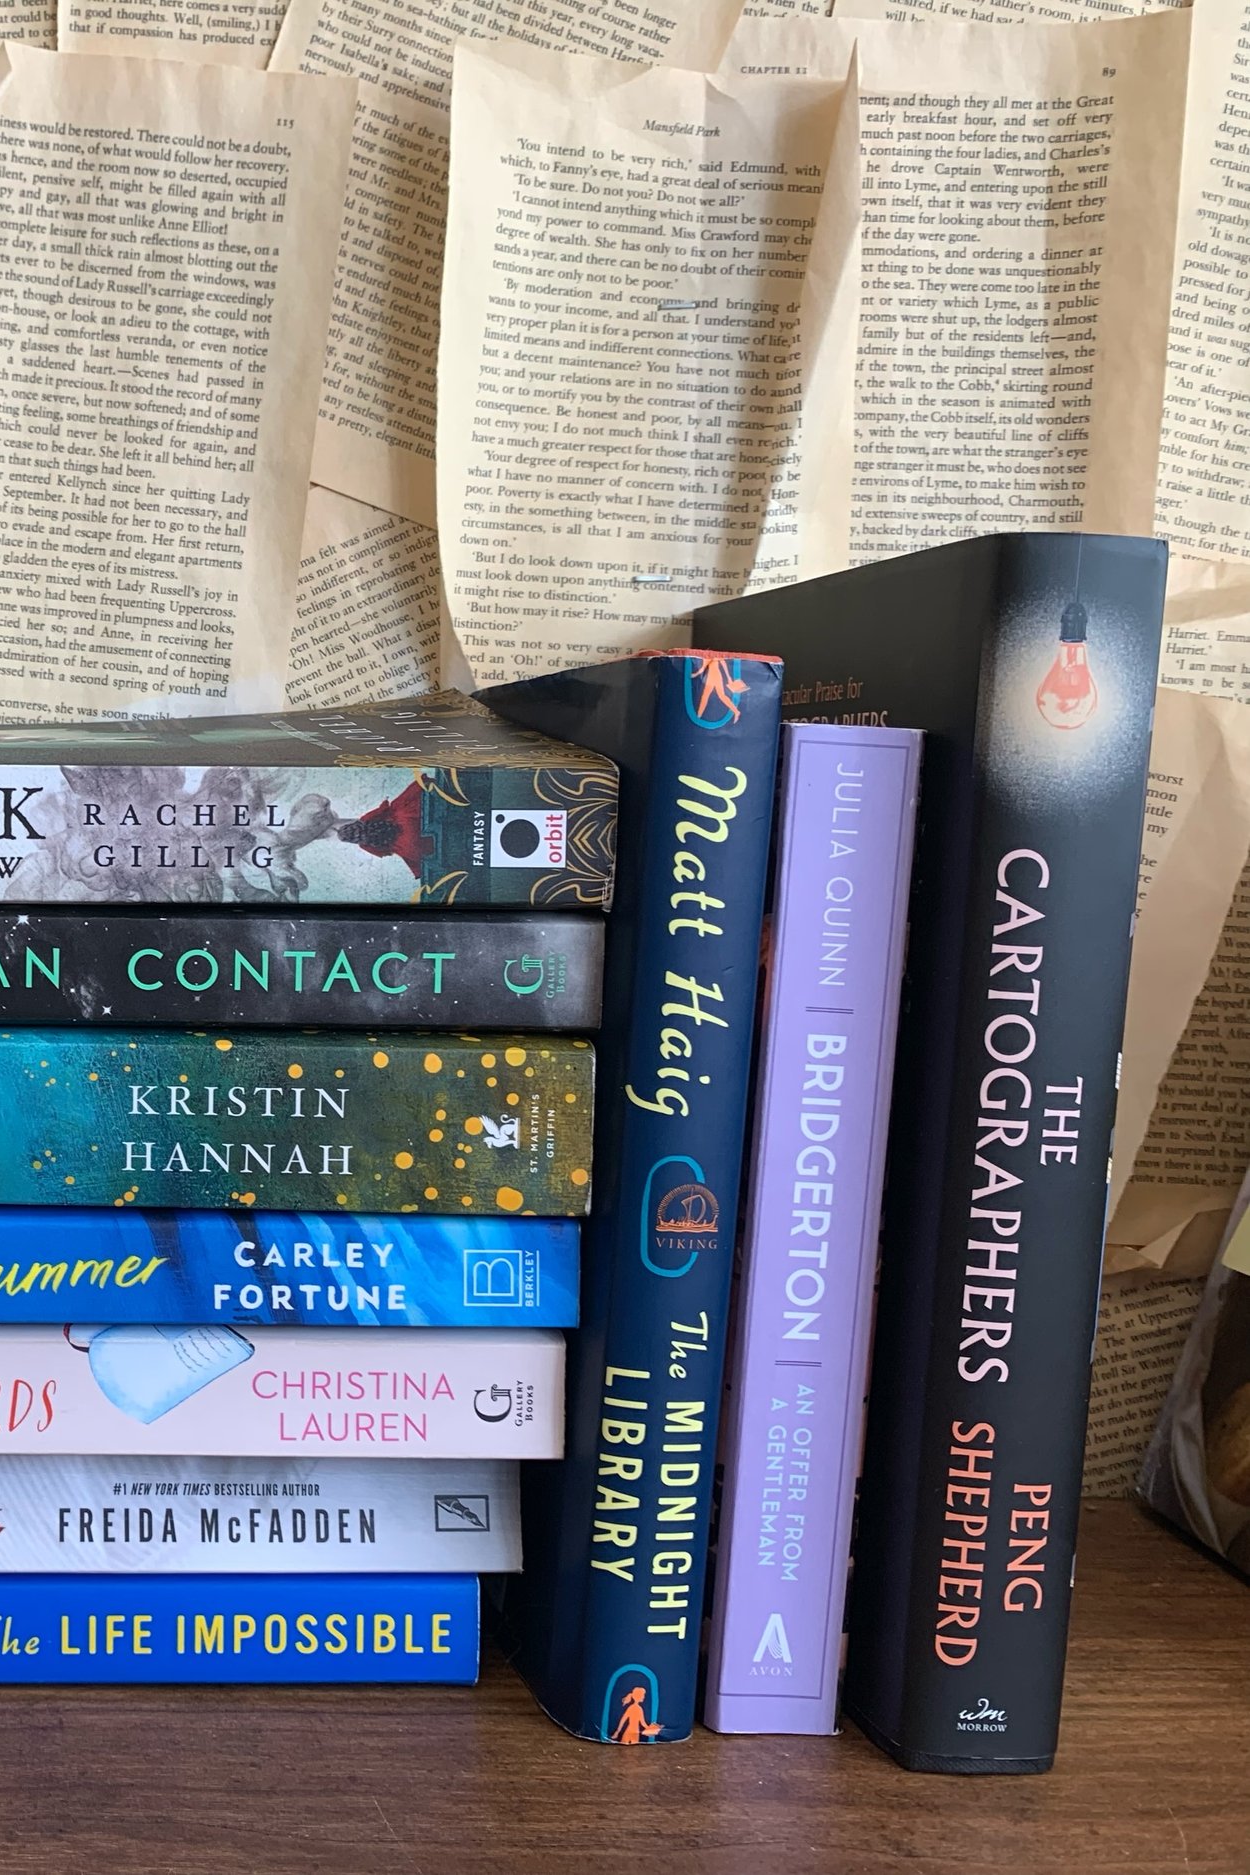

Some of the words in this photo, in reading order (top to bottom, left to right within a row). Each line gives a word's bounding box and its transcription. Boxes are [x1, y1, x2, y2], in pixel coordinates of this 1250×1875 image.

[741, 66, 790, 74] CHAPTER
[1102, 67, 1116, 78] 89
[643, 120, 693, 137] Mansfield
[696, 124, 720, 138] Park
[866, 112, 896, 126] early
[903, 111, 957, 125] breakfast
[964, 112, 996, 126] hour,
[1003, 112, 1025, 126] and
[1033, 113, 1049, 127] set
[1056, 112, 1077, 125] off
[1085, 112, 1112, 127] very
[815, 680, 843, 702] Praise
[847, 676, 863, 699] for
[84, 804, 286, 826] RACHEL
[828, 763, 863, 860] JULIA
[93, 845, 275, 868] GILLIG
[472, 810, 484, 866] FANTASY
[547, 813, 565, 863] orbit
[669, 766, 747, 938] Matt
[819, 876, 854, 987] QUINN
[127, 949, 455, 994] CONTACT
[625, 970, 730, 1119] Haig
[128, 1084, 350, 1118] KRISTIN
[530, 1093, 540, 1148] MARTIN'S
[957, 848, 1049, 1384] CARTOGRAPHERS
[1040, 1076, 1085, 1166] THE
[546, 1109, 555, 1158] GRIFFIN
[121, 1141, 354, 1175] HANNAH
[781, 1034, 848, 1341] BRIDGERTON
[234, 1242, 394, 1268] CARLEY
[656, 1237, 718, 1250] VIKING
[213, 1285, 406, 1310] FORTUNE
[525, 1250, 535, 1307] BERKLEY
[669, 1311, 709, 1380] The
[252, 1371, 455, 1400] CHRISTINA
[515, 1379, 523, 1427] GALLERY
[525, 1385, 534, 1422] BOOKS
[771, 1398, 788, 1412] A
[796, 1384, 815, 1416] AN
[280, 1413, 428, 1442] LAUREN
[590, 1365, 650, 1582] LIBRARY
[787, 1427, 811, 1501] OFFER
[113, 1483, 127, 1496] #1
[131, 1483, 152, 1496] NEW
[155, 1483, 180, 1496] YORK
[183, 1483, 211, 1496] TIMES
[214, 1483, 279, 1497] BESTSELLING
[282, 1484, 320, 1497] AUTHOR
[757, 1426, 786, 1567] GENTLEMAN
[59, 1508, 178, 1543] FREIDA
[201, 1508, 376, 1544] McFADDEN
[647, 1401, 705, 1640] MIDNIGHT
[780, 1515, 805, 1582] FROM
[934, 1421, 996, 1667] SHEPHERD
[1004, 1483, 1052, 1612] PENG
[61, 1615, 153, 1655] LIFE
[177, 1614, 452, 1654] IMPOSSIBLE
[748, 1666, 794, 1676] AVON
[957, 1722, 1008, 1732] MORROW
